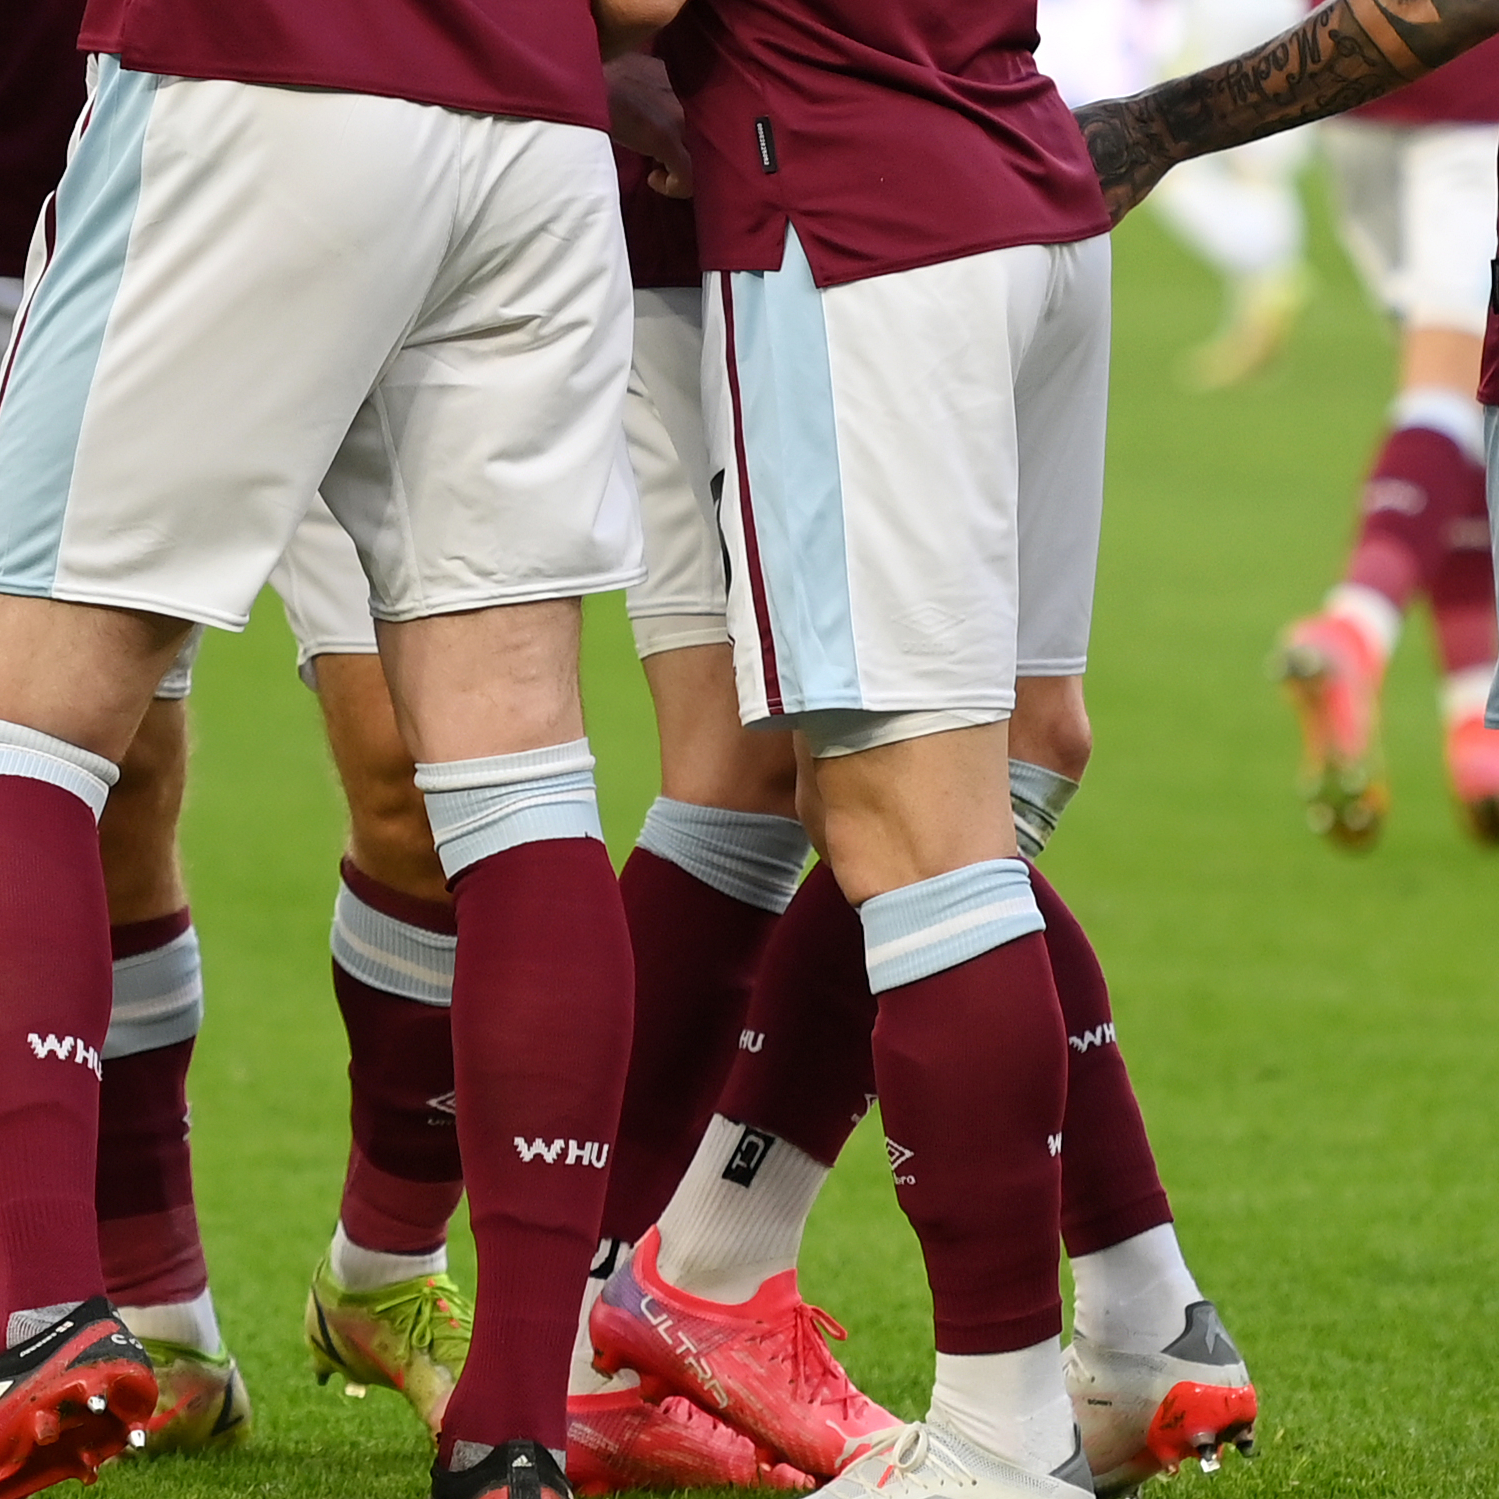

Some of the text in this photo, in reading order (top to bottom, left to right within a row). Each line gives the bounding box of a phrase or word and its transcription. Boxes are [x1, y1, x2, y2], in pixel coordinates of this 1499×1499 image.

[739, 1029, 766, 1053] HU
[1068, 1022, 1117, 1054] WH
[27, 1033, 103, 1082] WHU
[513, 1136, 609, 1169] WHU
[640, 1295, 729, 1409] ULTRA
